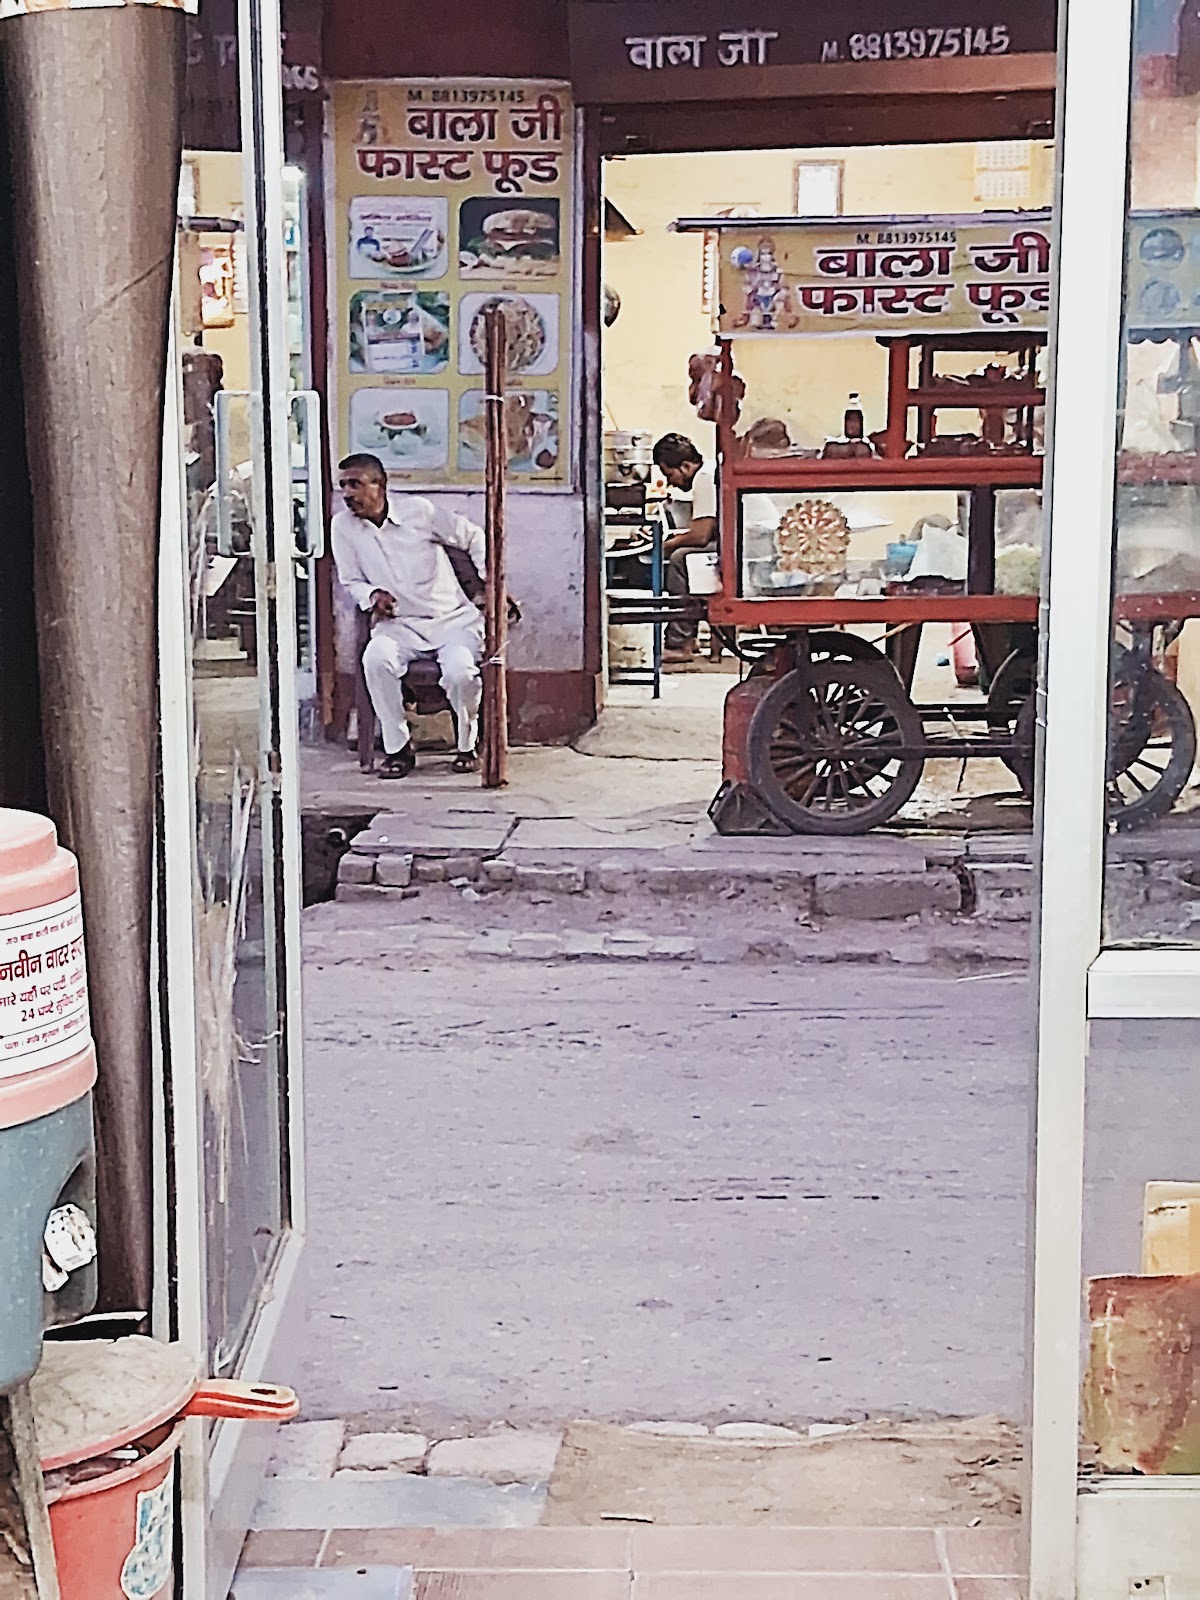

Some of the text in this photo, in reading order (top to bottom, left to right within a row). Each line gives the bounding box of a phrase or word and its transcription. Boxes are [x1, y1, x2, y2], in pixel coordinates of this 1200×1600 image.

[849, 24, 1010, 61] 8813975145
[431, 89, 526, 103] 8813975145
[406, 93, 565, 142] बाला जी
[356, 149, 563, 193] फास्ट फूड
[816, 231, 1051, 279] बाला जी
[876, 231, 957, 244] 8813975145
[798, 284, 955, 315] फास्ट
[0, 949, 42, 982] नवीन
[45, 943, 70, 969] वाटर
[21, 1007, 35, 1022] 24
